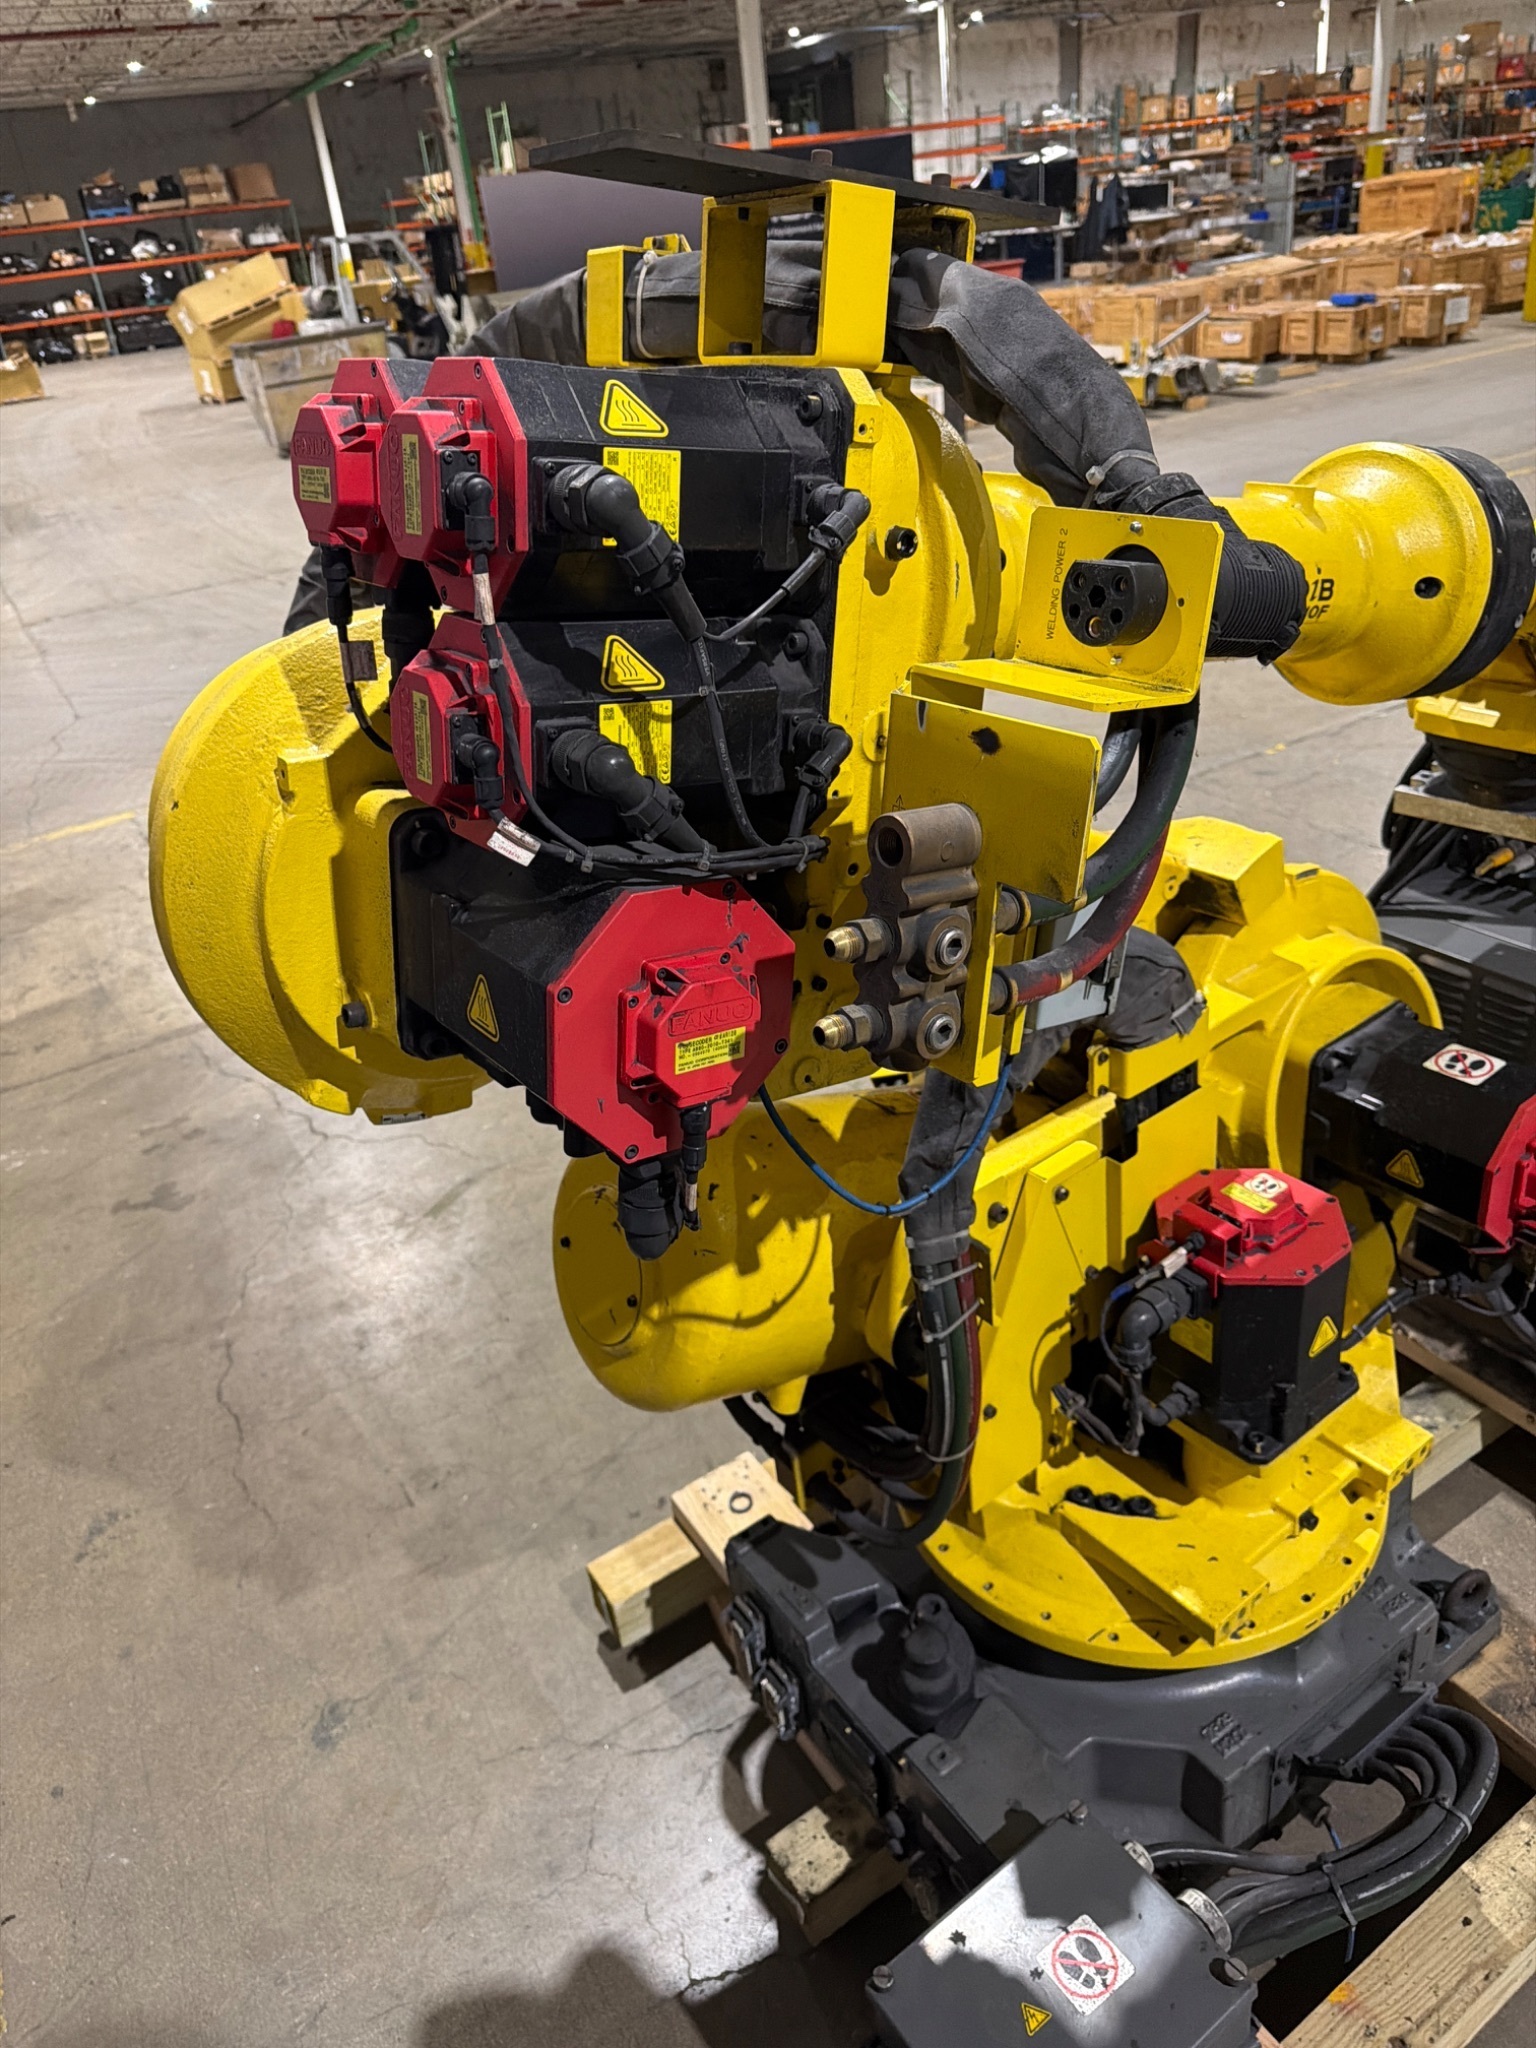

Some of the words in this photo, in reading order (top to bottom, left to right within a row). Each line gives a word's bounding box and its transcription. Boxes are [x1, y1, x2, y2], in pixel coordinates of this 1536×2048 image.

[1059, 527, 1069, 537] 2
[1053, 540, 1066, 584] POWER
[1045, 587, 1060, 641] WELDING
[670, 1004, 747, 1033] FANUC
